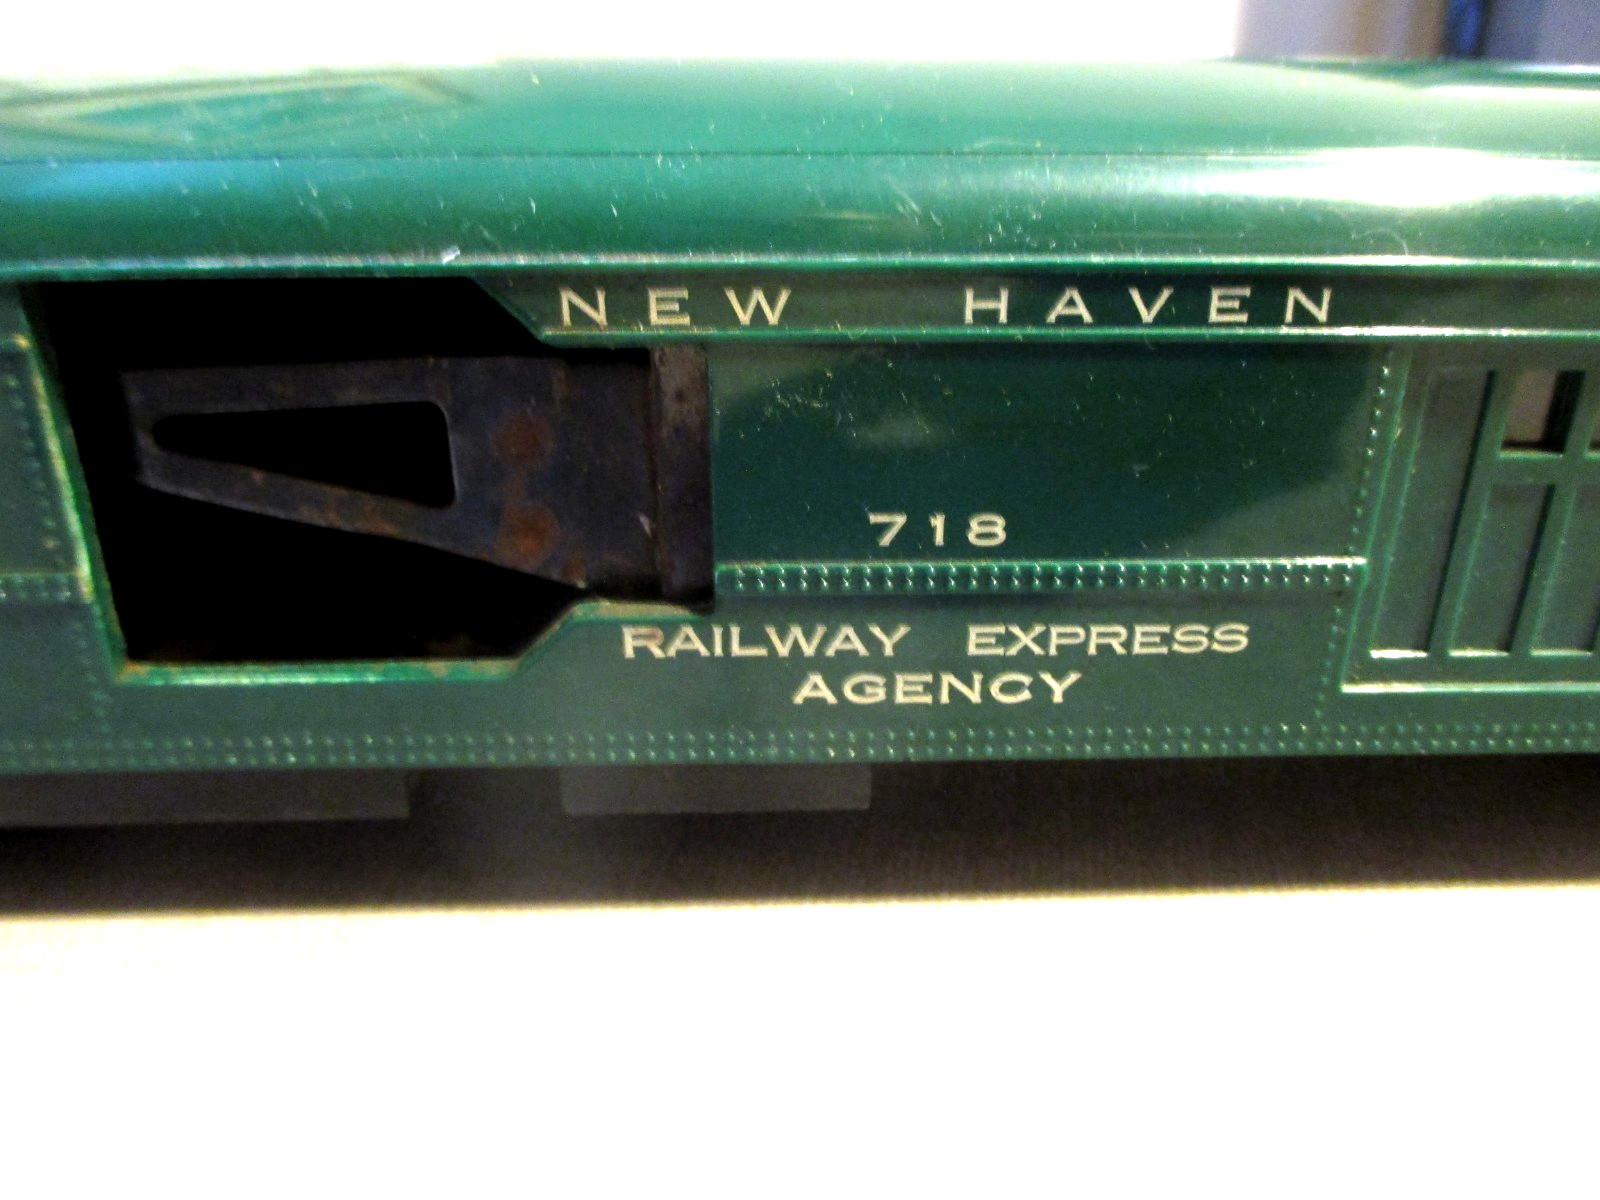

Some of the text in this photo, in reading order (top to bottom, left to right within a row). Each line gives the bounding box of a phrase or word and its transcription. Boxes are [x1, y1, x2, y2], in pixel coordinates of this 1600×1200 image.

[560, 287, 1333, 327] NEW HAVEN
[868, 512, 1008, 548] 718
[621, 622, 1250, 660] RAILWAY EXPRESS
[792, 670, 1082, 706] AGENCY
